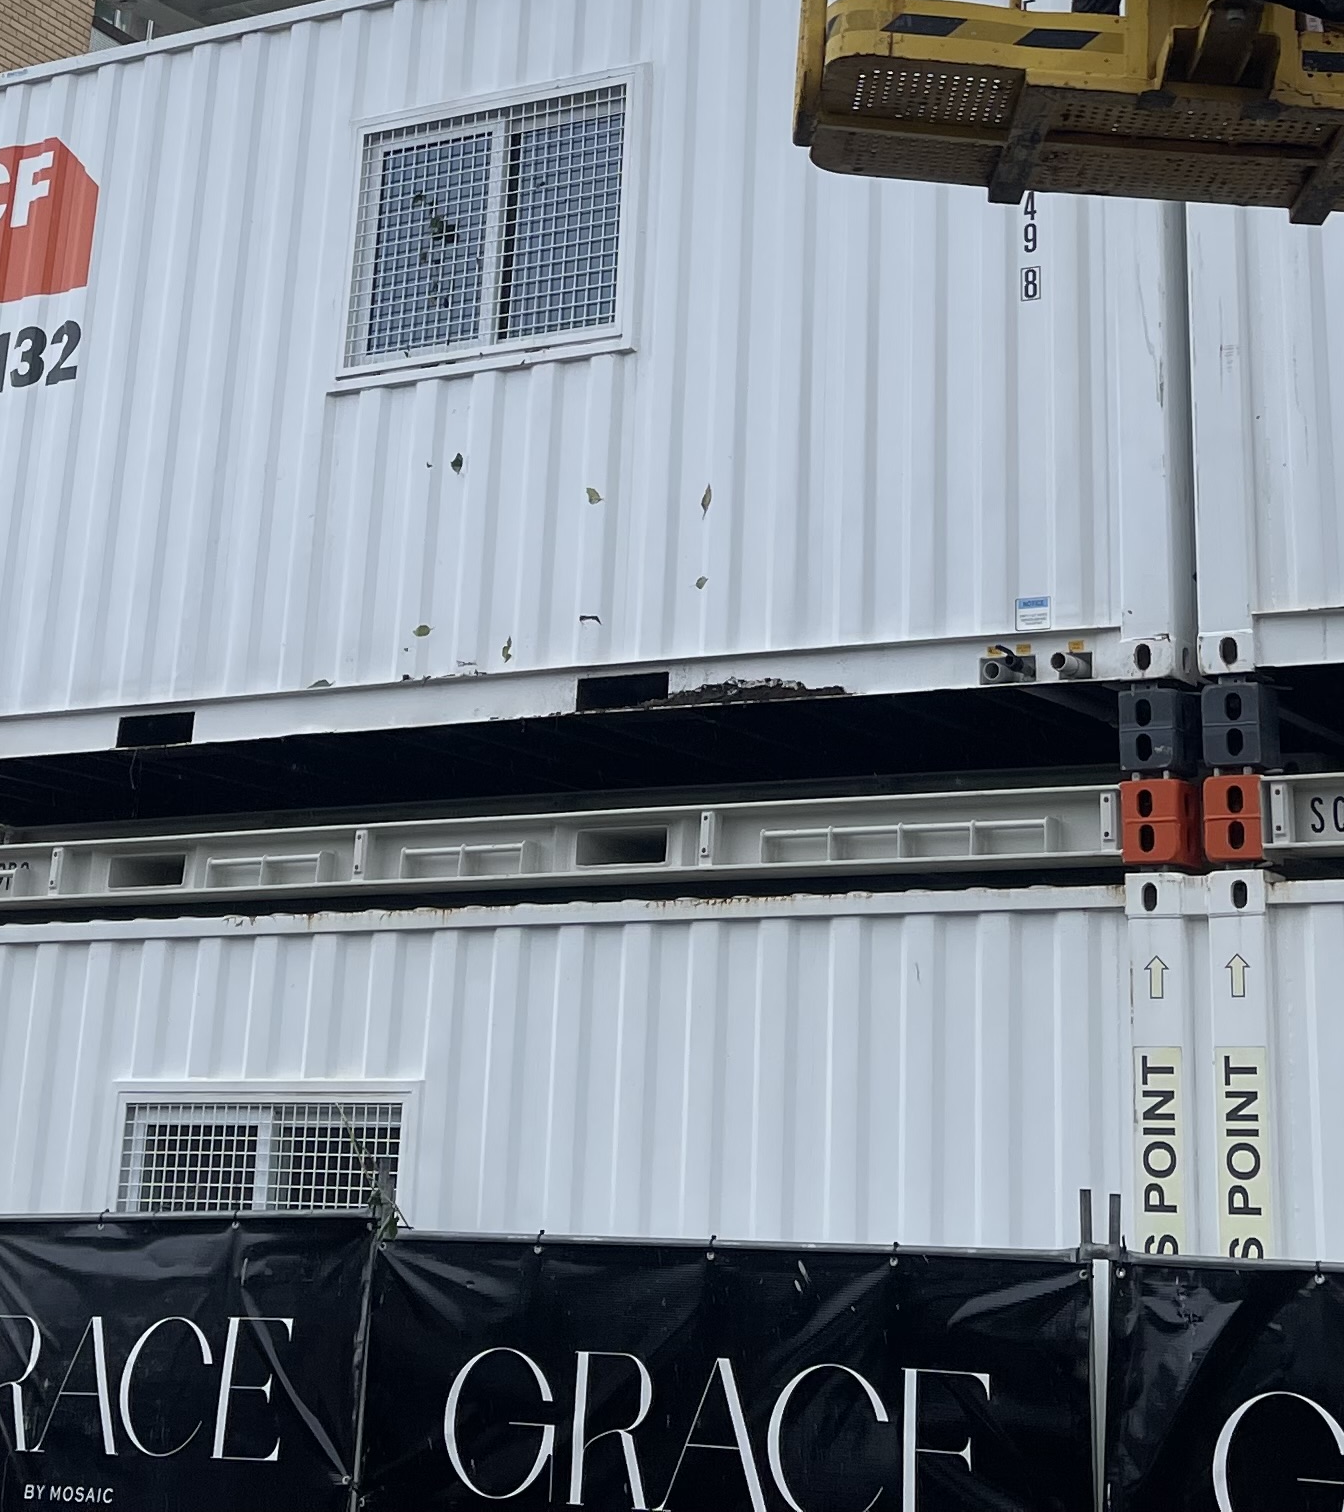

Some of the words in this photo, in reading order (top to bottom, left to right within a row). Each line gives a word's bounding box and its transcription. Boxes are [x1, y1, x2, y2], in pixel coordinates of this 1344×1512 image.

[1141, 1055, 1178, 1214] POINT
[1223, 1055, 1263, 1216] POINT
[23, 1484, 46, 1500] BY
[49, 1485, 114, 1504] MOSAIC
[443, 1347, 992, 1512] GRACE
